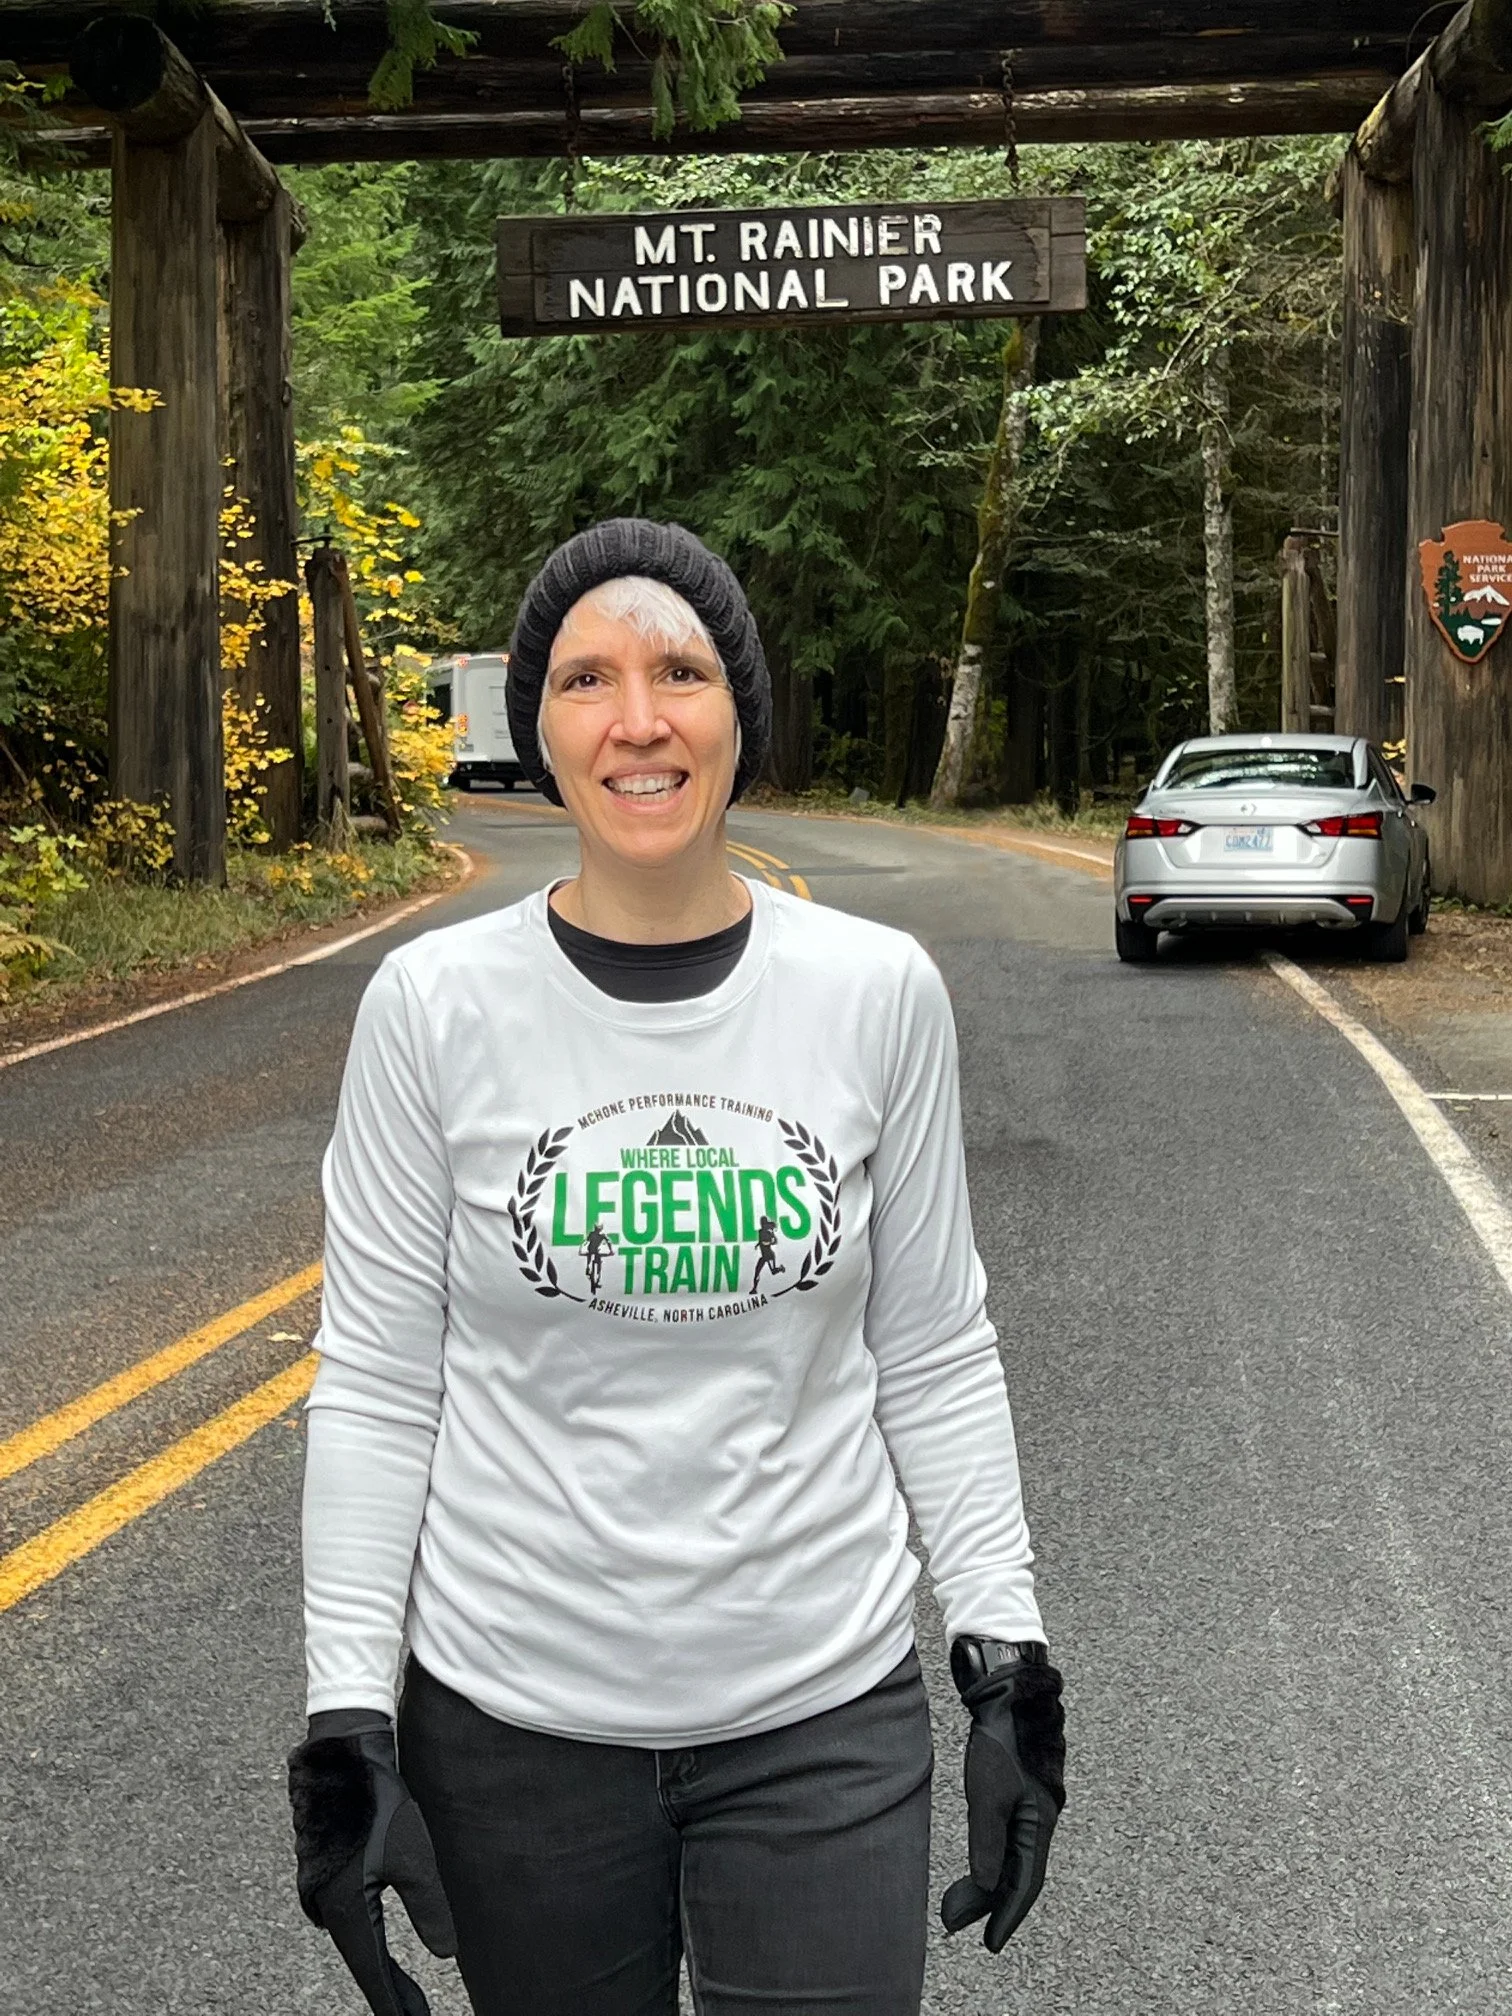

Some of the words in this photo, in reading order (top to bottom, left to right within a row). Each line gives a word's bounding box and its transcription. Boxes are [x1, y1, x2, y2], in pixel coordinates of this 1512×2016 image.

[633, 222, 716, 267] MT.
[739, 212, 944, 263] RAINIER
[568, 267, 850, 319] NATIONAL
[878, 260, 1015, 307] PARK
[1462, 554, 1512, 564] NATIONA
[1476, 564, 1507, 574] PARK
[1469, 573, 1512, 583] SERVICE
[577, 1101, 627, 1130] MCHONE
[628, 1093, 717, 1111] PERFORMANCE
[719, 1096, 775, 1123] TRAINING
[620, 1147, 681, 1169] WHERE
[686, 1146, 740, 1168] LOCAL
[551, 1165, 812, 1247] LEGENDS
[618, 1244, 741, 1295] TRAIN
[588, 1297, 659, 1323] ASHEVILLE,
[663, 1308, 704, 1323] NORTH
[708, 1293, 769, 1321] CAROLINA
